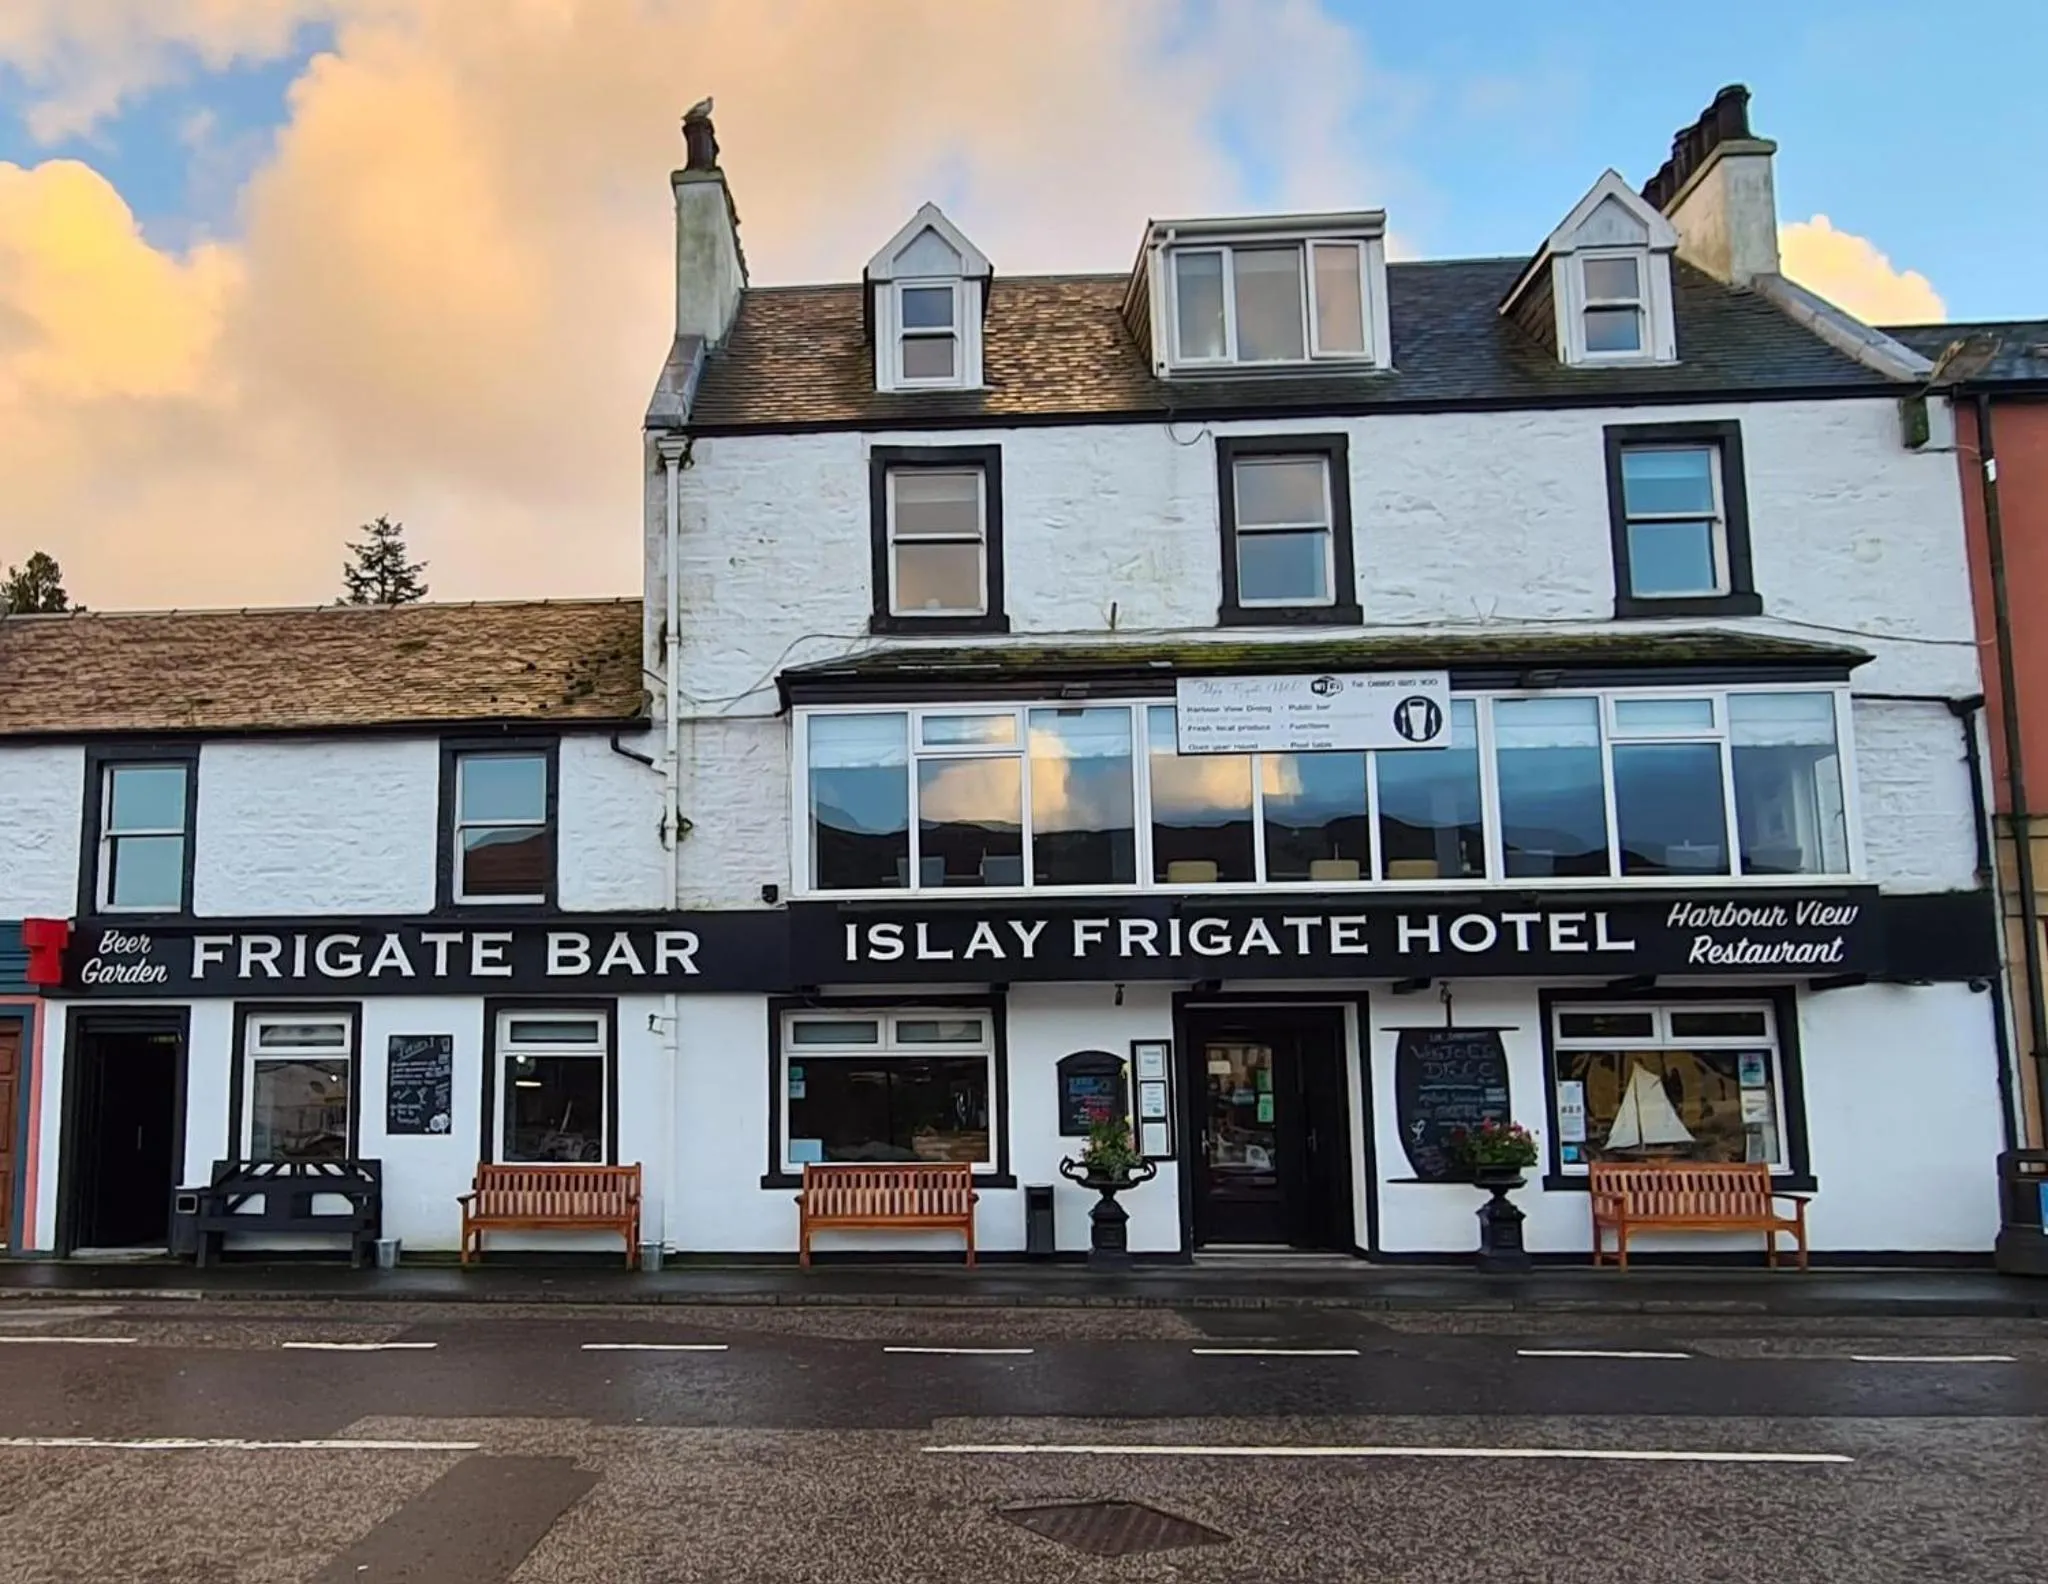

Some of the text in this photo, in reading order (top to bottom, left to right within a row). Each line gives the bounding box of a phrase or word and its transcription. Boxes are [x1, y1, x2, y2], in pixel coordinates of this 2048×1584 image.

[1666, 900, 1859, 928] Harbour View
[98, 929, 152, 955] Beer
[844, 912, 1636, 962] ISLAY FRIGATE HOTEL
[1688, 934, 1844, 965] Restaurant
[191, 930, 701, 979] FRIGATE BAR
[81, 957, 168, 984] Garden
